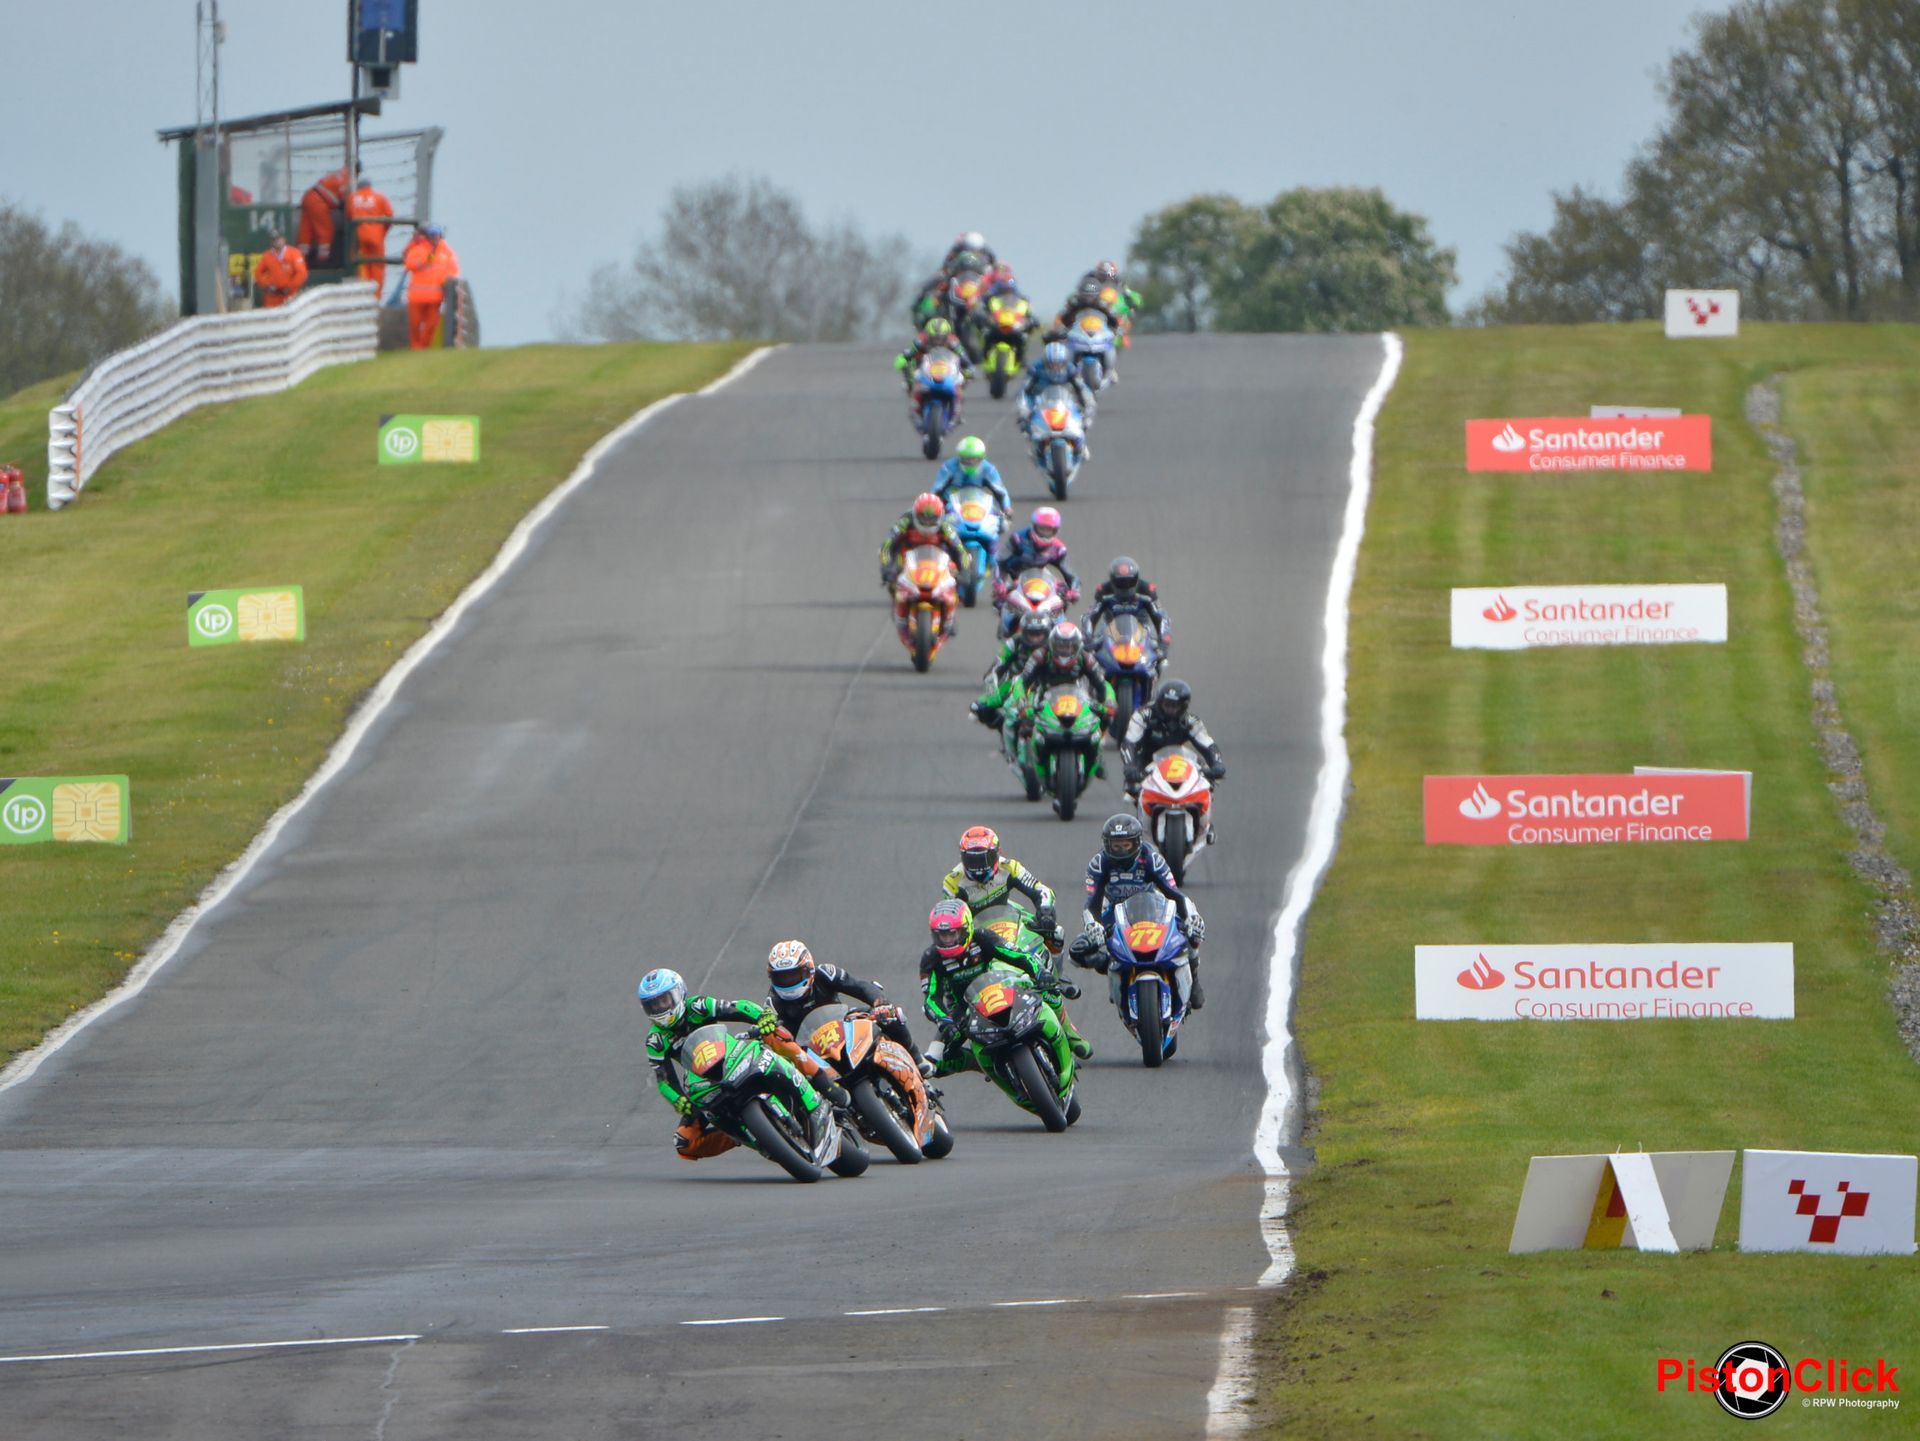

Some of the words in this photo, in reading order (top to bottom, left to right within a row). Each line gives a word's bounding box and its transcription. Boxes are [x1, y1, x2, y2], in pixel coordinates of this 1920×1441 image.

[1529, 427, 1664, 450] Santander
[1529, 453, 1615, 470] Consumer
[1619, 452, 1686, 469] Finance
[201, 611, 226, 631] 1p
[1524, 598, 1674, 622] Santander
[1524, 627, 1621, 645] Consumer
[1625, 625, 1699, 644] Finance
[1507, 789, 1684, 818] Santander
[11, 803, 38, 827] 1p
[1508, 824, 1622, 844] Consumer
[1627, 822, 1712, 842] Finance
[1130, 928, 1162, 948] 77
[1514, 959, 1720, 990] Santander
[982, 989, 1008, 1014] 2
[1514, 998, 1648, 1018] Consumer
[1654, 998, 1753, 1018] Finance
